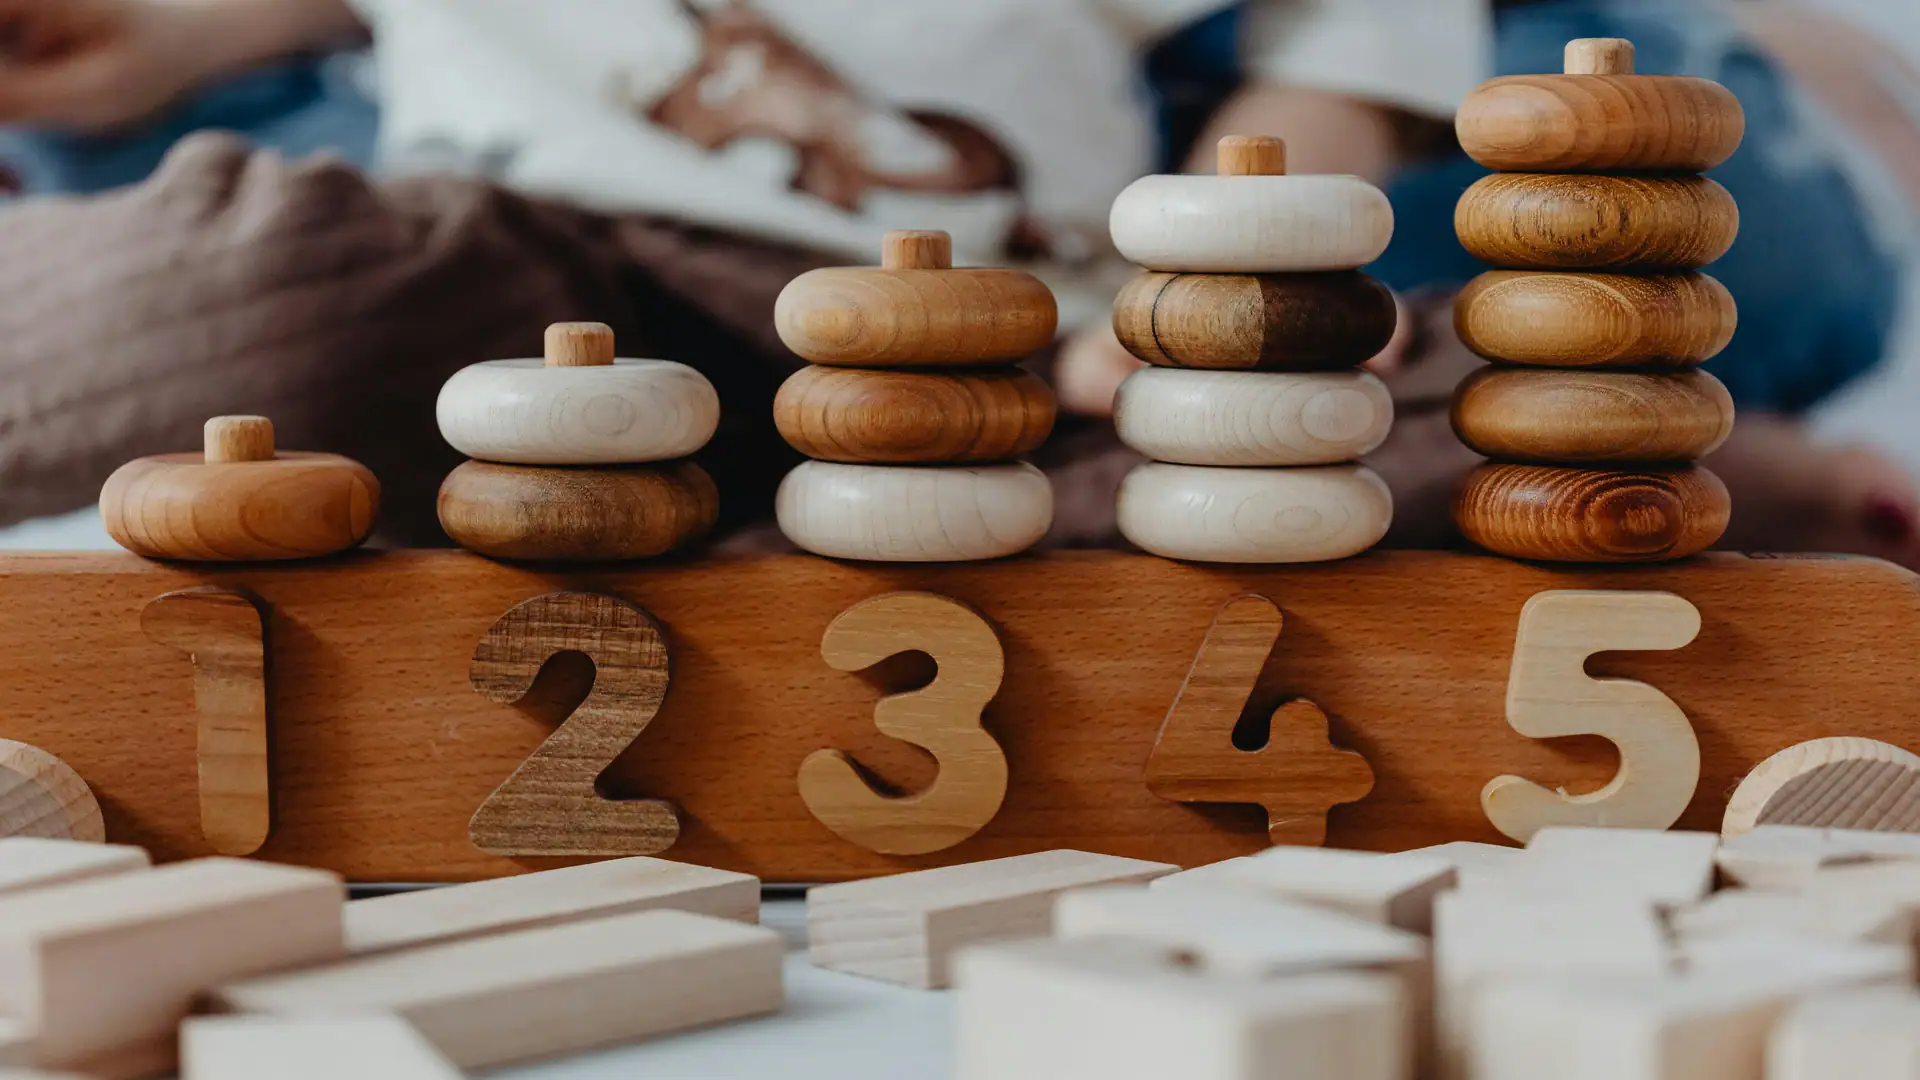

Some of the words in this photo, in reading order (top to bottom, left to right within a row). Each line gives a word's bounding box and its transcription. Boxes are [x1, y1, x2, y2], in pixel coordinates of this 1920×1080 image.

[140, 586, 270, 856] 1
[469, 591, 680, 856] 2
[798, 591, 1008, 855] 3
[1145, 593, 1375, 846] 4
[1481, 589, 1701, 844] 5
